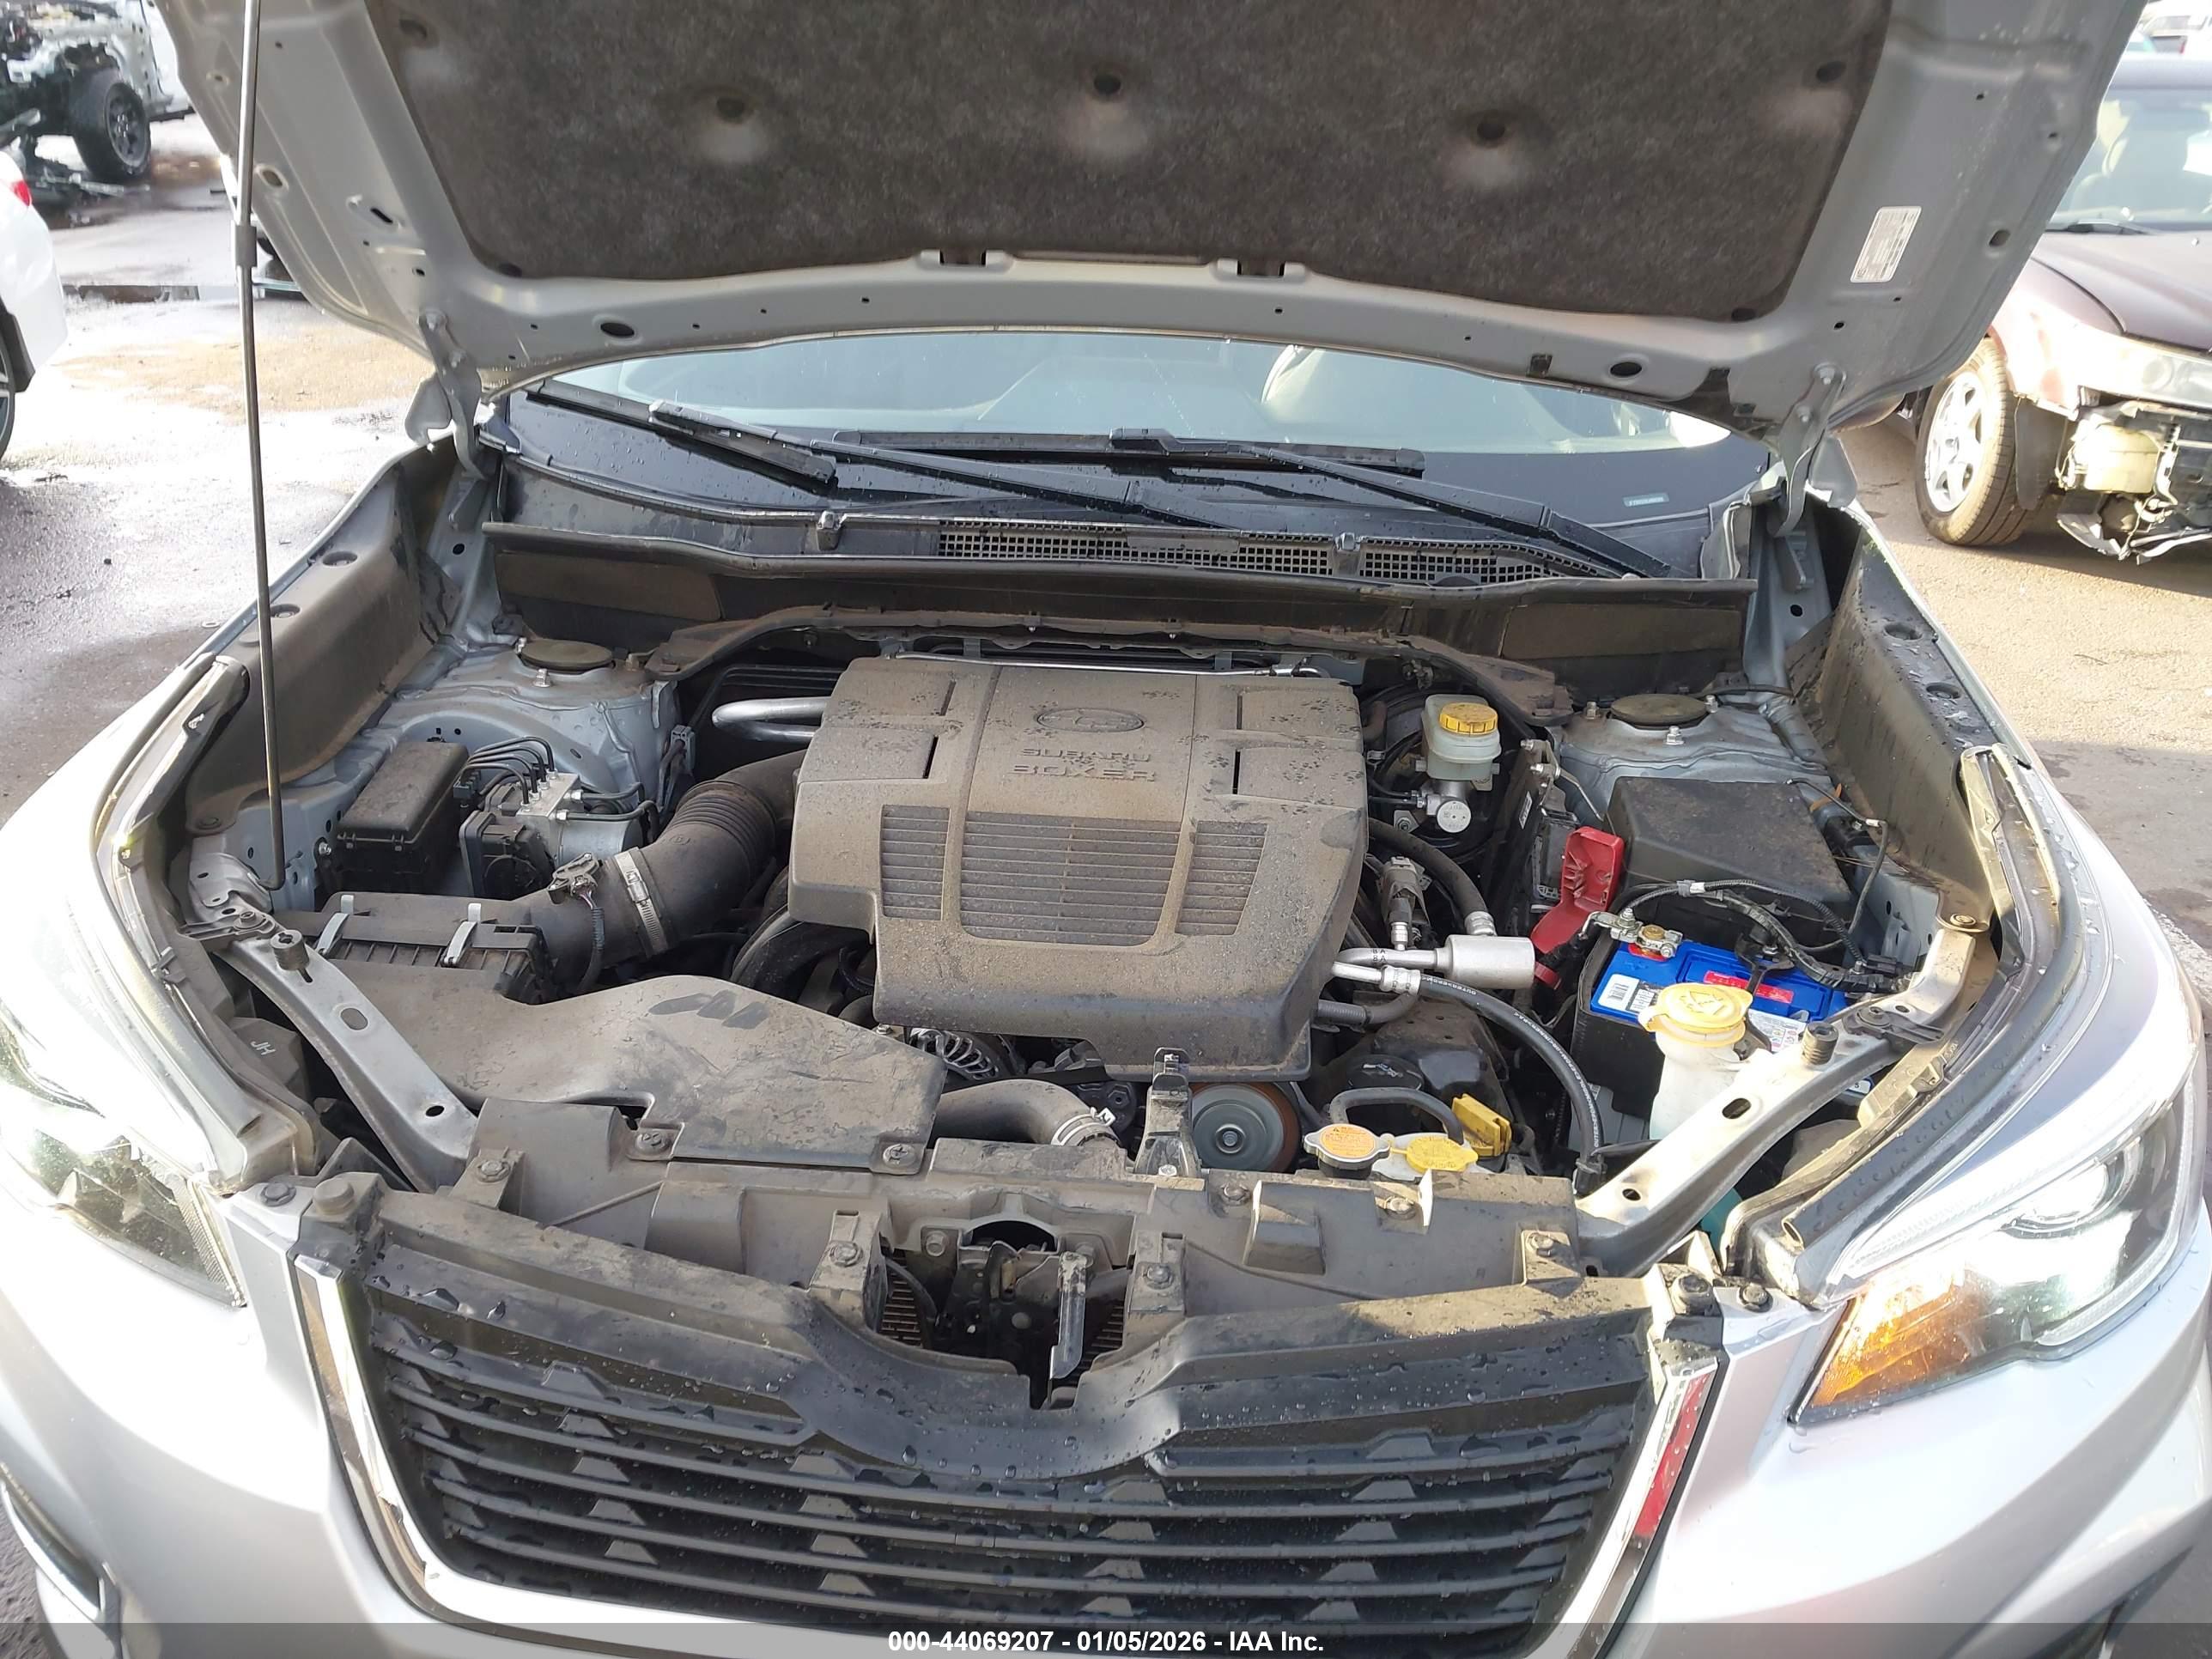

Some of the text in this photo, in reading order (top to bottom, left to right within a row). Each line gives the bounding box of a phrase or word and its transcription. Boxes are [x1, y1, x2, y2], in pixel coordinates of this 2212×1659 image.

[1019, 748, 1152, 763] SUBARU
[1013, 764, 1156, 782] BOXER
[250, 1041, 276, 1055] JH
